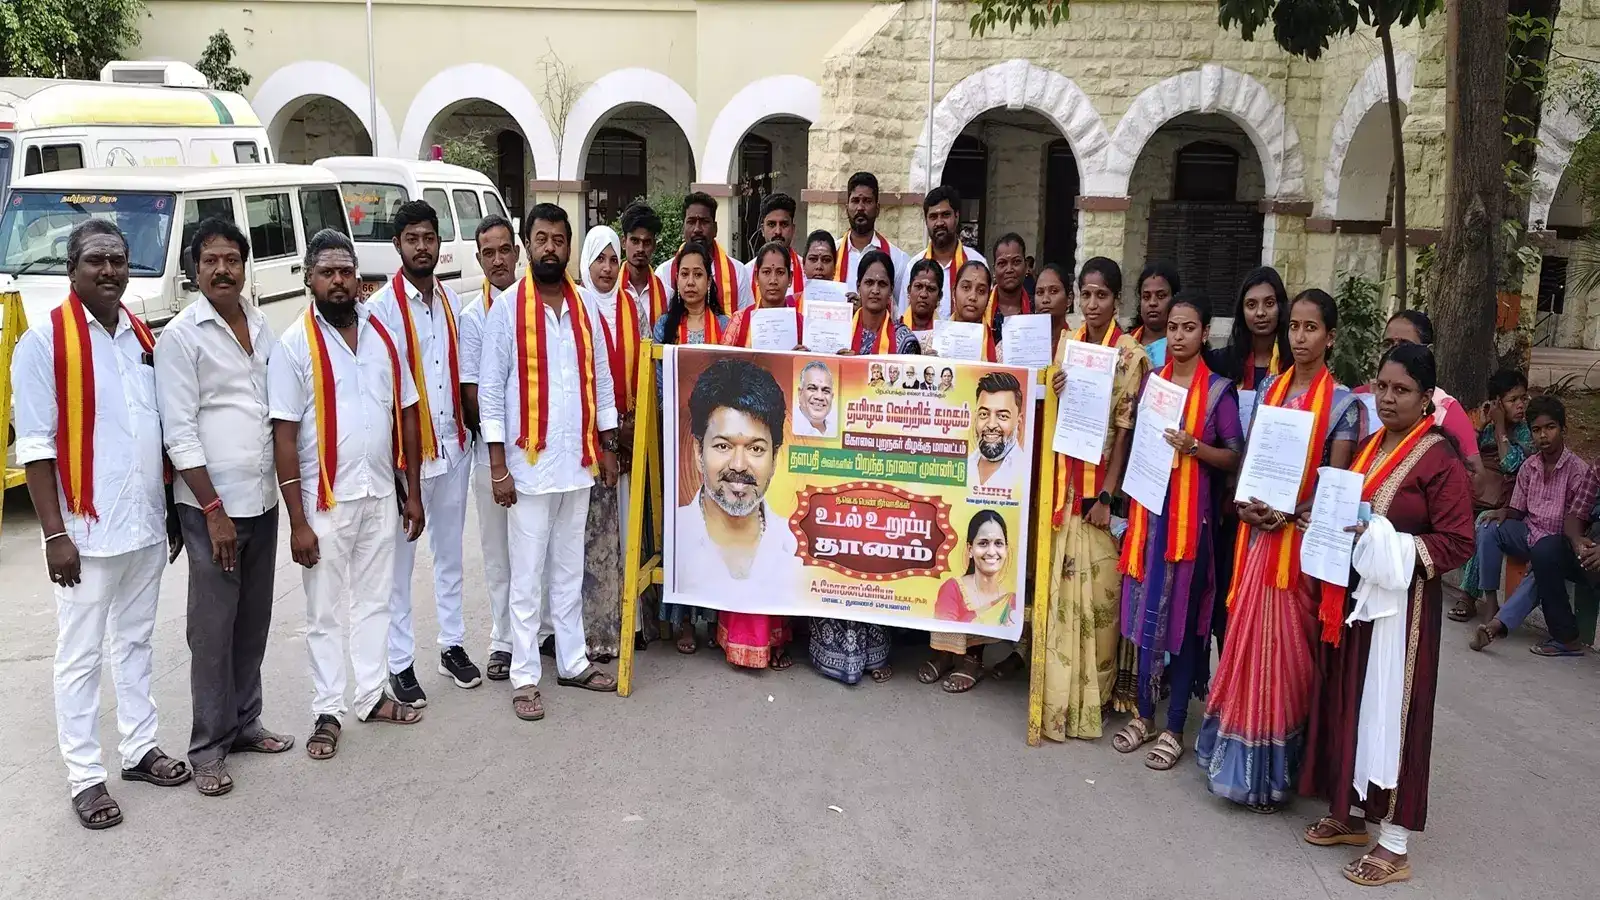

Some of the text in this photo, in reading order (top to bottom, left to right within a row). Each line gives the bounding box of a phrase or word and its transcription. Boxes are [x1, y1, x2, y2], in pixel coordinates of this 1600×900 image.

[846, 398, 970, 434] தமிழக வெற்றிக் கழகம்
[844, 433, 967, 455] கோவை புறநகர் கிழக்கு மாவட்டம்
[790, 450, 819, 472] தளபதி
[855, 454, 884, 477] பிறந்த
[885, 459, 917, 478] நாளை
[919, 458, 966, 482] முன்னிட்டு
[815, 505, 932, 540] உடல் உறுப்பு
[813, 538, 933, 562] தானம்
